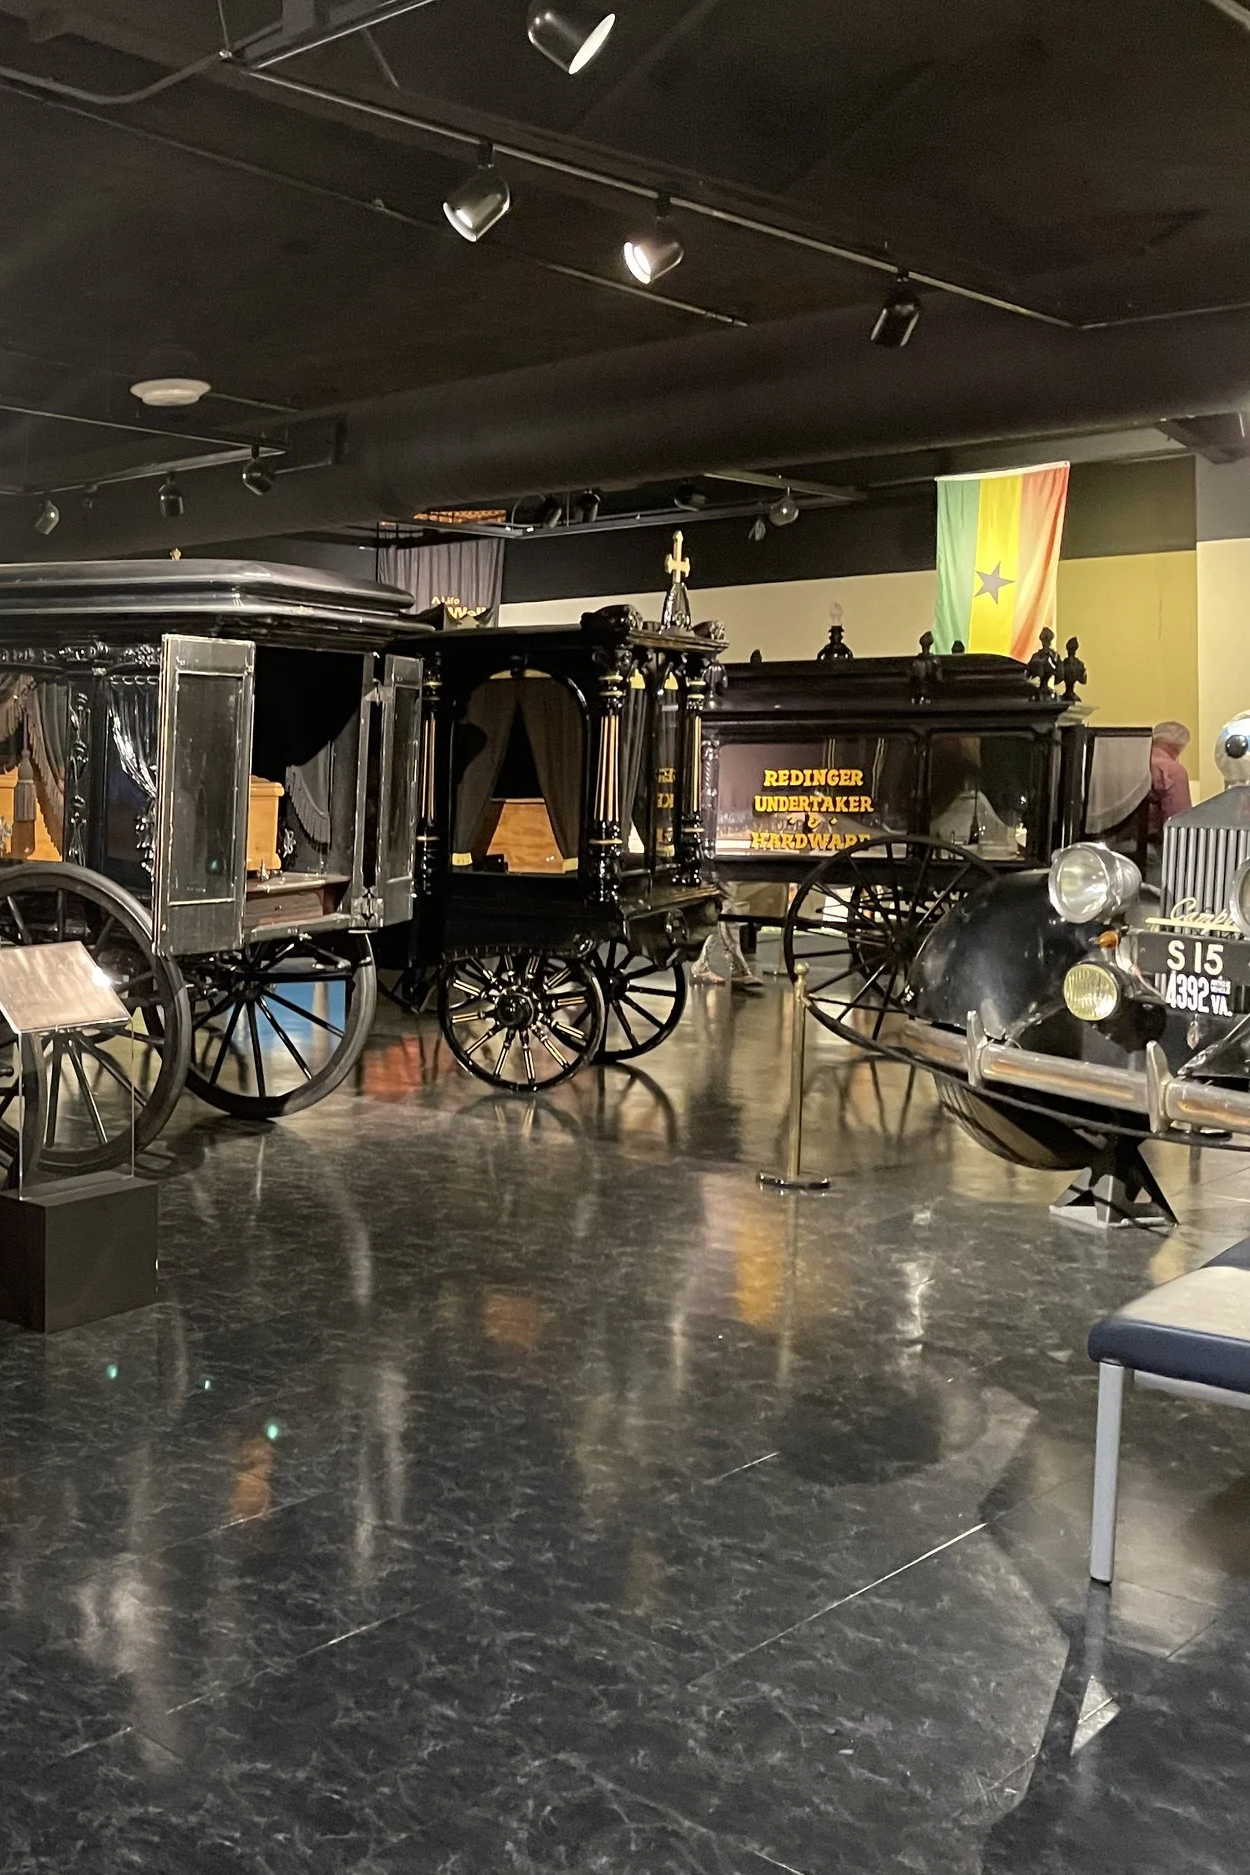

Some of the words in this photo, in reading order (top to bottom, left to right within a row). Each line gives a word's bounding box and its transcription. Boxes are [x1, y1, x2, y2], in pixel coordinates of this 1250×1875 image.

[763, 768, 864, 787] REDINGER
[754, 795, 874, 812] UNDERTAKER
[1170, 897, 1237, 935] Camp
[1166, 939, 1186, 971] S
[1193, 941, 1224, 976] 15
[1165, 970, 1210, 1013] 4392
[1210, 994, 1233, 1017] VA.
